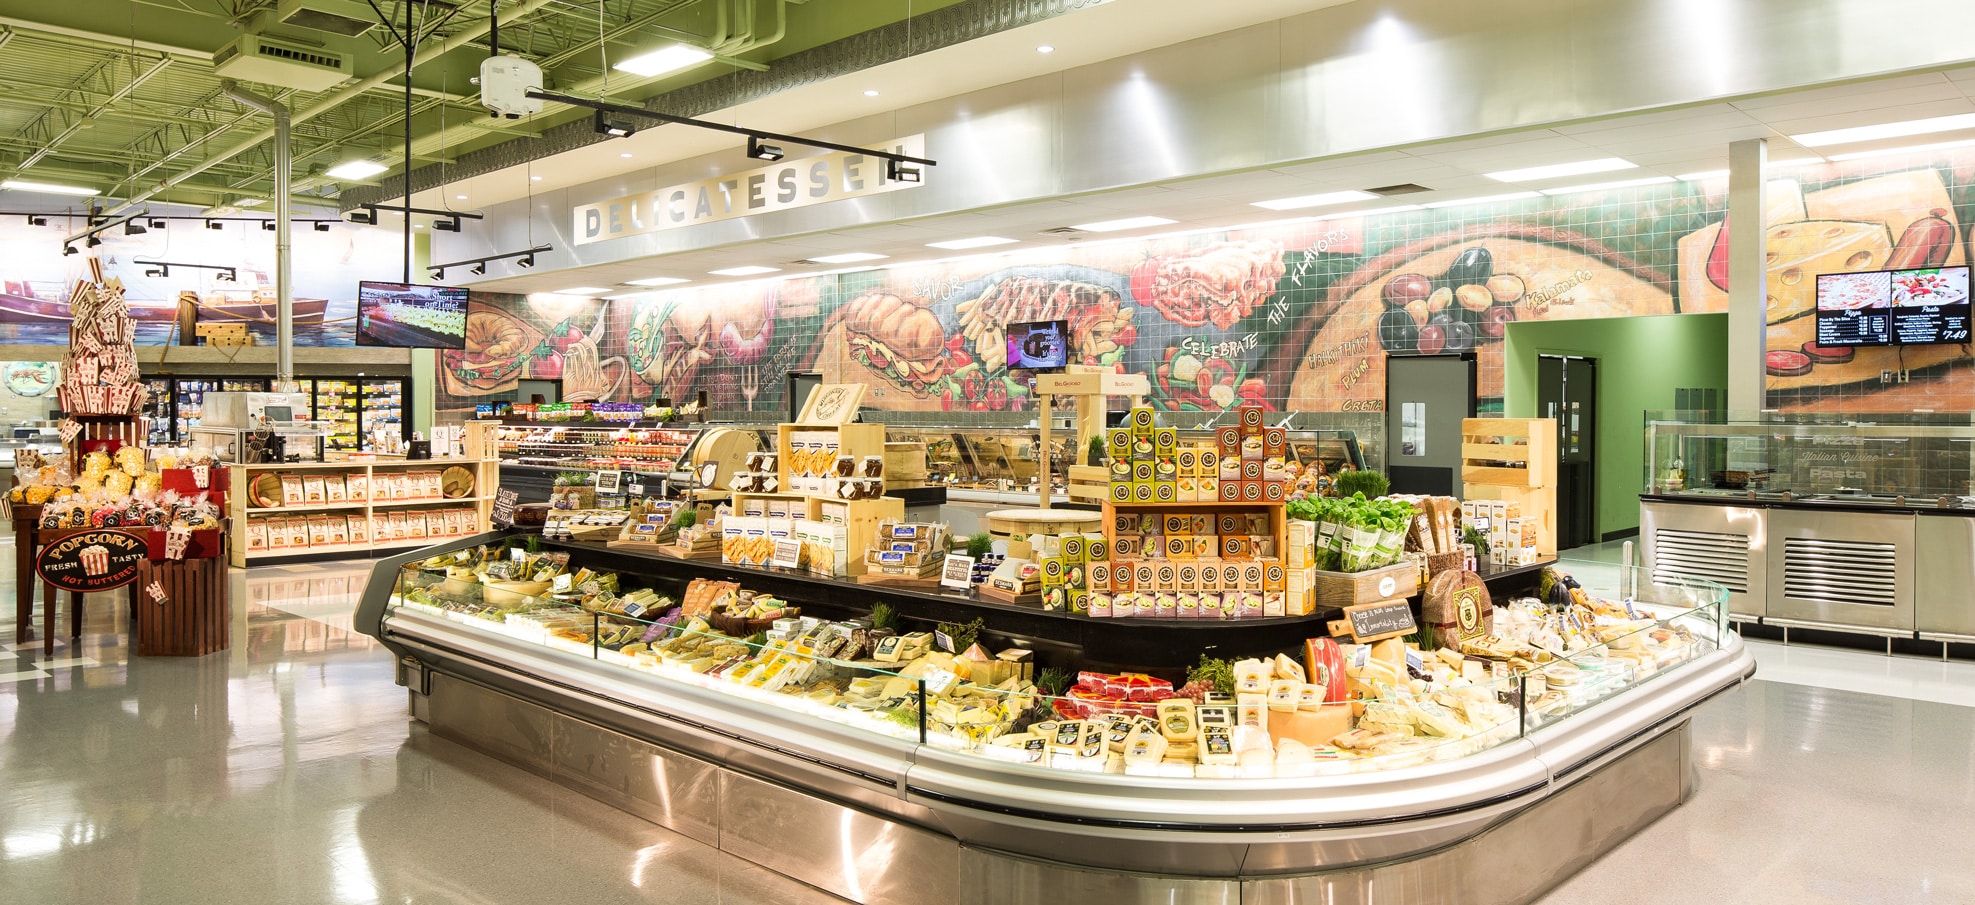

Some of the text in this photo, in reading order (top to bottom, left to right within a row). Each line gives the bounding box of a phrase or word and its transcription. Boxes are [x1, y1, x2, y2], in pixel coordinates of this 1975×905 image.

[586, 144, 907, 239] DELICATESSEN
[432, 290, 453, 301] Short
[912, 275, 964, 301] SAVOR
[1181, 228, 1349, 359] CELEBRATE THE FLAVORS
[1525, 269, 1593, 310] Kalamata
[1844, 309, 1862, 318] Pizza
[1942, 330, 1968, 340] $7.49
[1341, 358, 1370, 390] PLUM
[1342, 398, 1384, 412] CRETA
[1812, 436, 1864, 446] Pizza
[1802, 452, 1880, 462] Italian Cuisine
[1810, 468, 1867, 479] Pasta
[48, 533, 140, 560] POPCORN
[44, 552, 144, 572] FRESH TASTY
[61, 564, 136, 586] HOT BUTTERED
